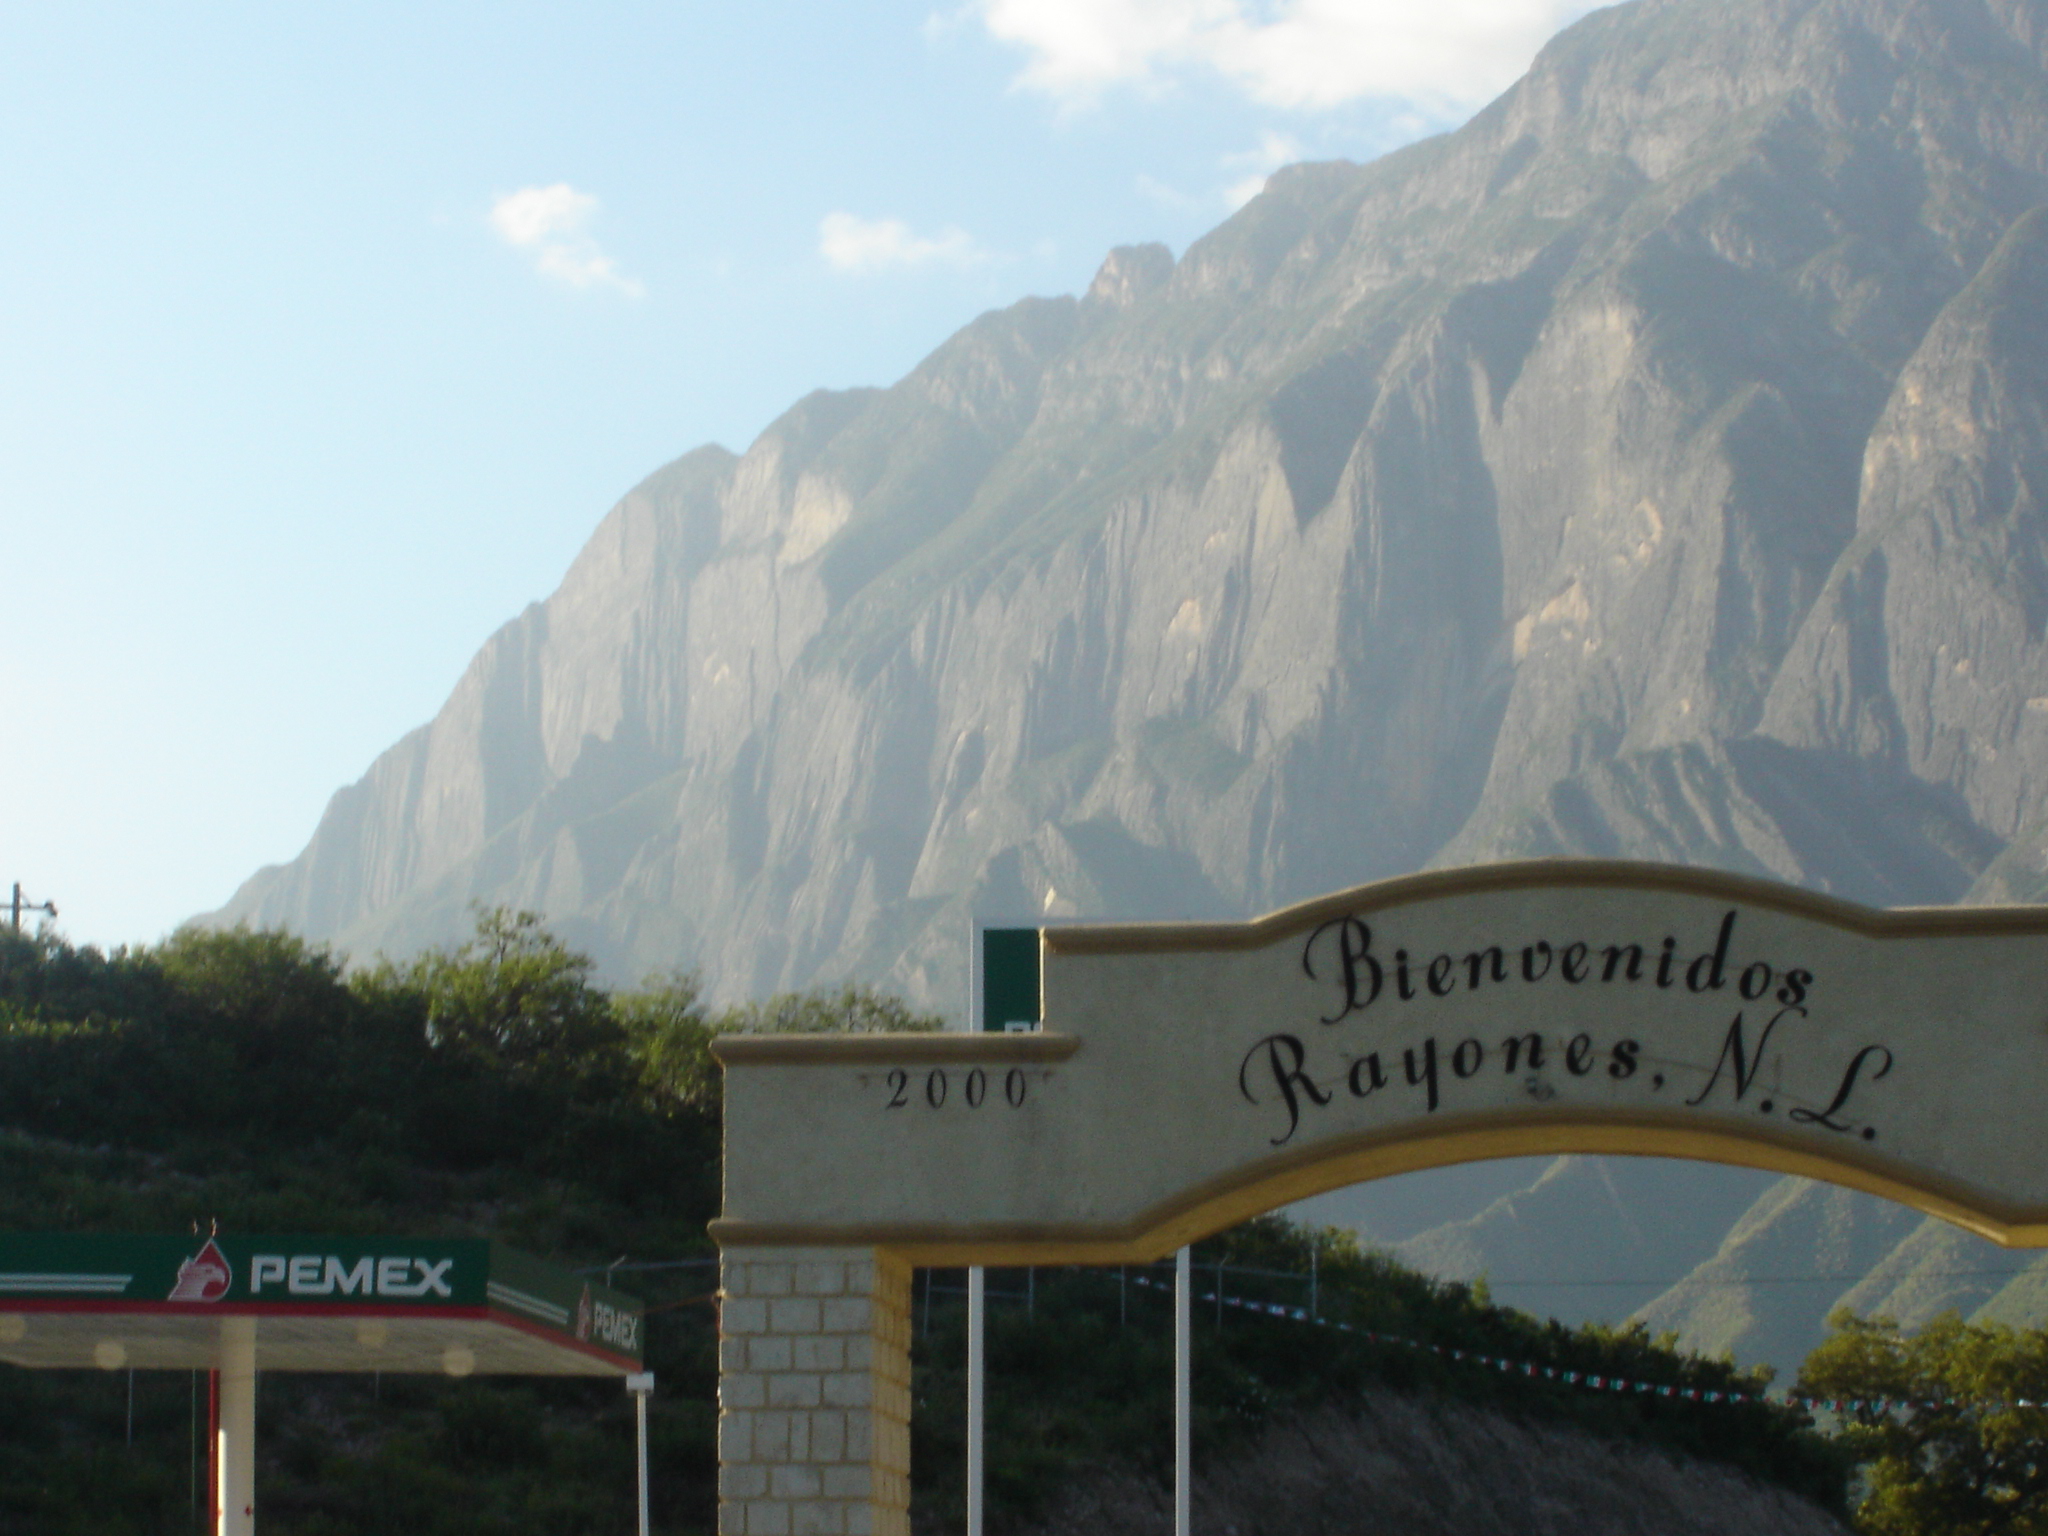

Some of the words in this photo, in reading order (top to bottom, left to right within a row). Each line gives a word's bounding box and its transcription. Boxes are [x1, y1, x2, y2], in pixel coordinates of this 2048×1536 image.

[1304, 910, 1813, 1025] Bienvenidos
[886, 1067, 1027, 1110] 2000
[1239, 1032, 1665, 1147] Rayones,
[249, 1255, 454, 1297] PEMEX
[593, 1300, 639, 1351] PEMEX
